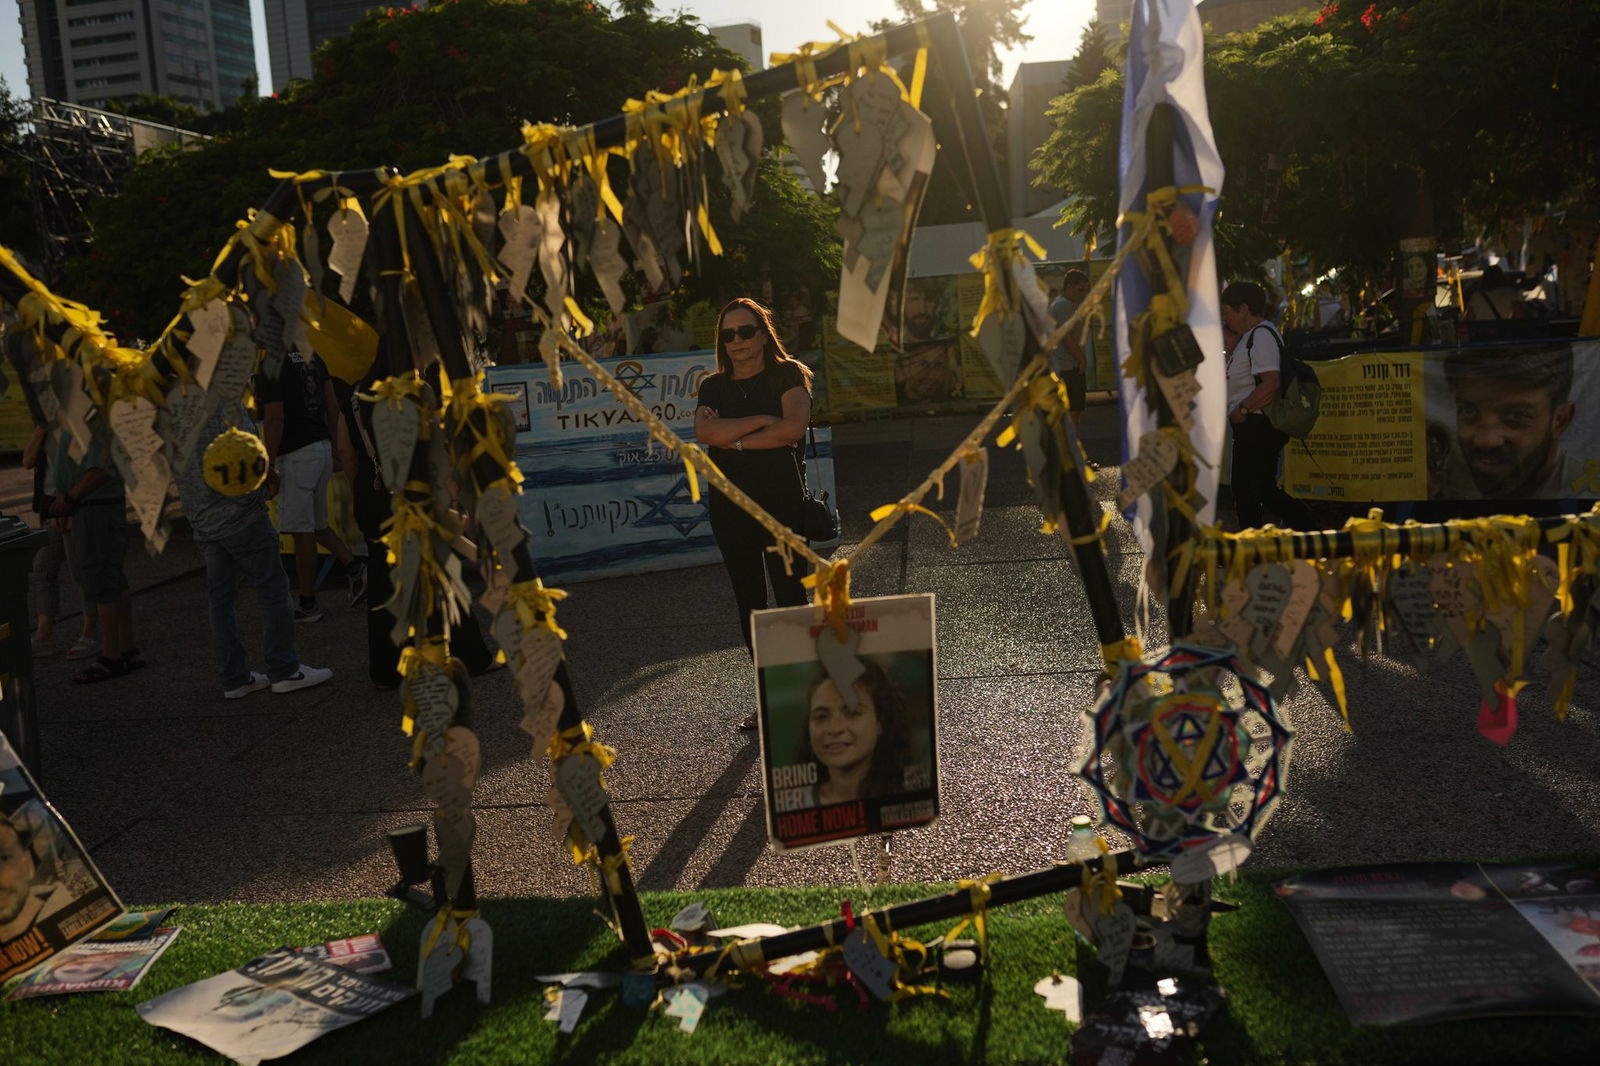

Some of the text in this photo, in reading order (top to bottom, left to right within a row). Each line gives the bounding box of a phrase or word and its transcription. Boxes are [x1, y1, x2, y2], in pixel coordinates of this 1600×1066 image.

[772, 761, 818, 789] BRING
[774, 788, 803, 814] HER
[776, 810, 817, 838] HOME
[822, 800, 865, 832] NOW!
